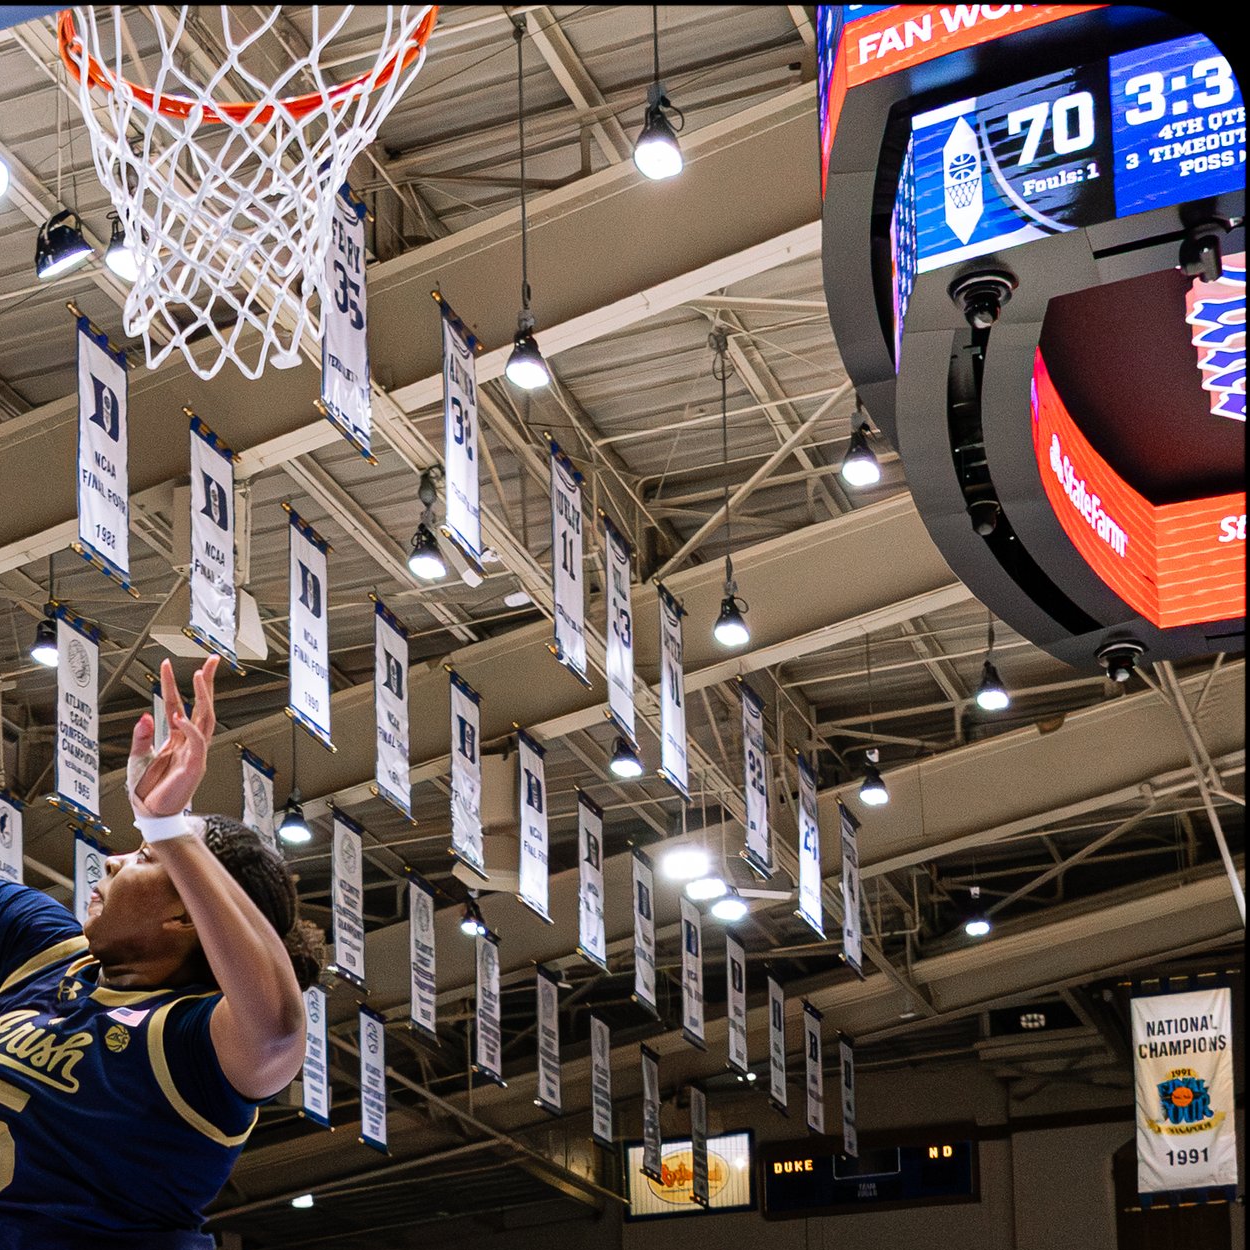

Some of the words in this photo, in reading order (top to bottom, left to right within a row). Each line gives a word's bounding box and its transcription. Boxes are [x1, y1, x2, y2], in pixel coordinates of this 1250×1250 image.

[859, 14, 932, 64] FAN
[1008, 91, 1095, 166] 70
[1158, 116, 1204, 140] 4TH
[1125, 153, 1139, 169] 3
[1179, 150, 1235, 177] POSS
[1022, 169, 1084, 196] Fouls:
[334, 259, 364, 331] 35
[94, 450, 116, 480] NCAA
[82, 468, 106, 498] FINAL
[205, 541, 225, 567] NCAA
[1146, 1014, 1218, 1037] NATIONAL
[1138, 1034, 1227, 1060] CHAMPIONS
[773, 1159, 814, 1175] DUKE
[1166, 1147, 1209, 1166] 1991
